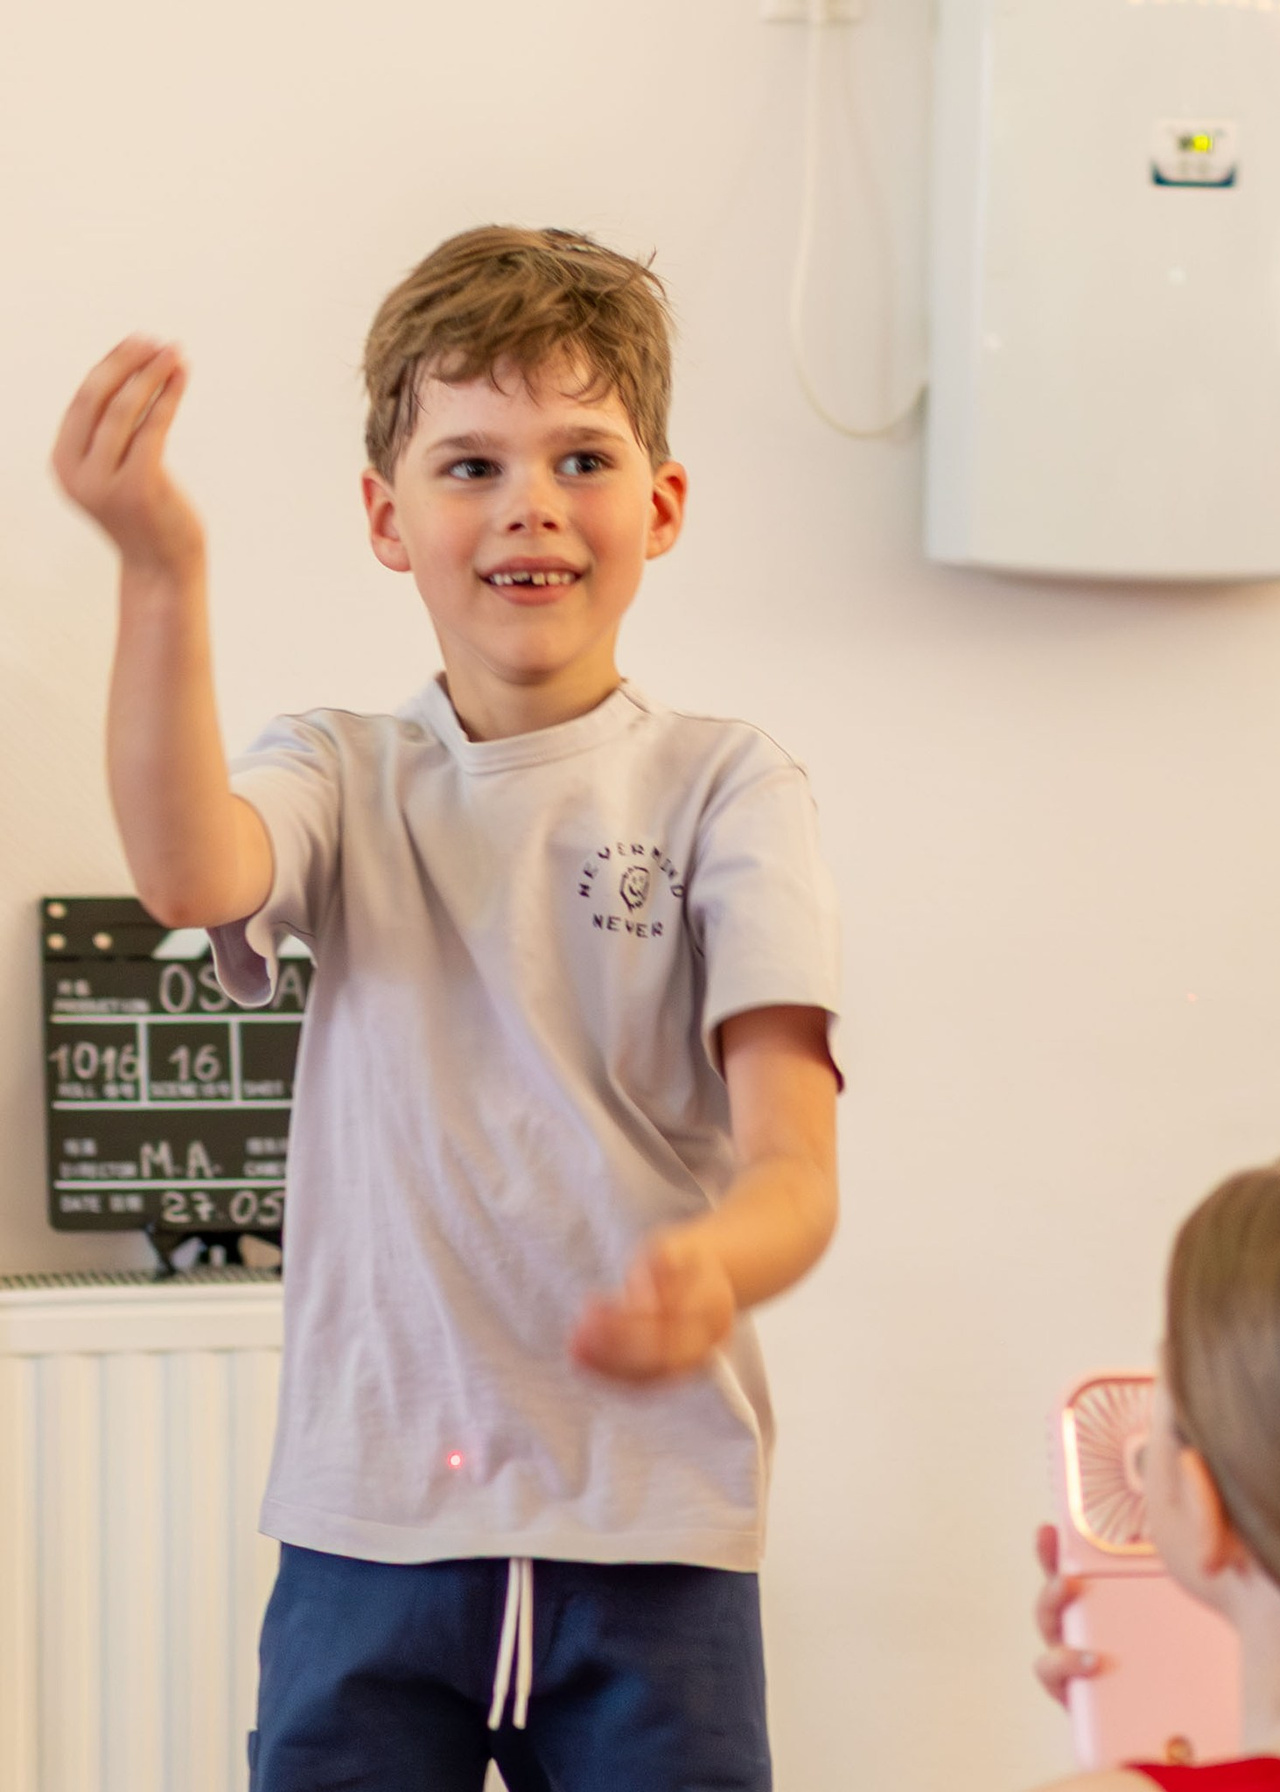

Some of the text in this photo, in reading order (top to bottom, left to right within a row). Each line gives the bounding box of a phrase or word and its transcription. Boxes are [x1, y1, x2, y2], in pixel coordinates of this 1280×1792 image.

[592, 913, 663, 939] NEVER
[159, 963, 306, 1013] OSA
[48, 1041, 139, 1082] 1016
[168, 1043, 222, 1082] 16
